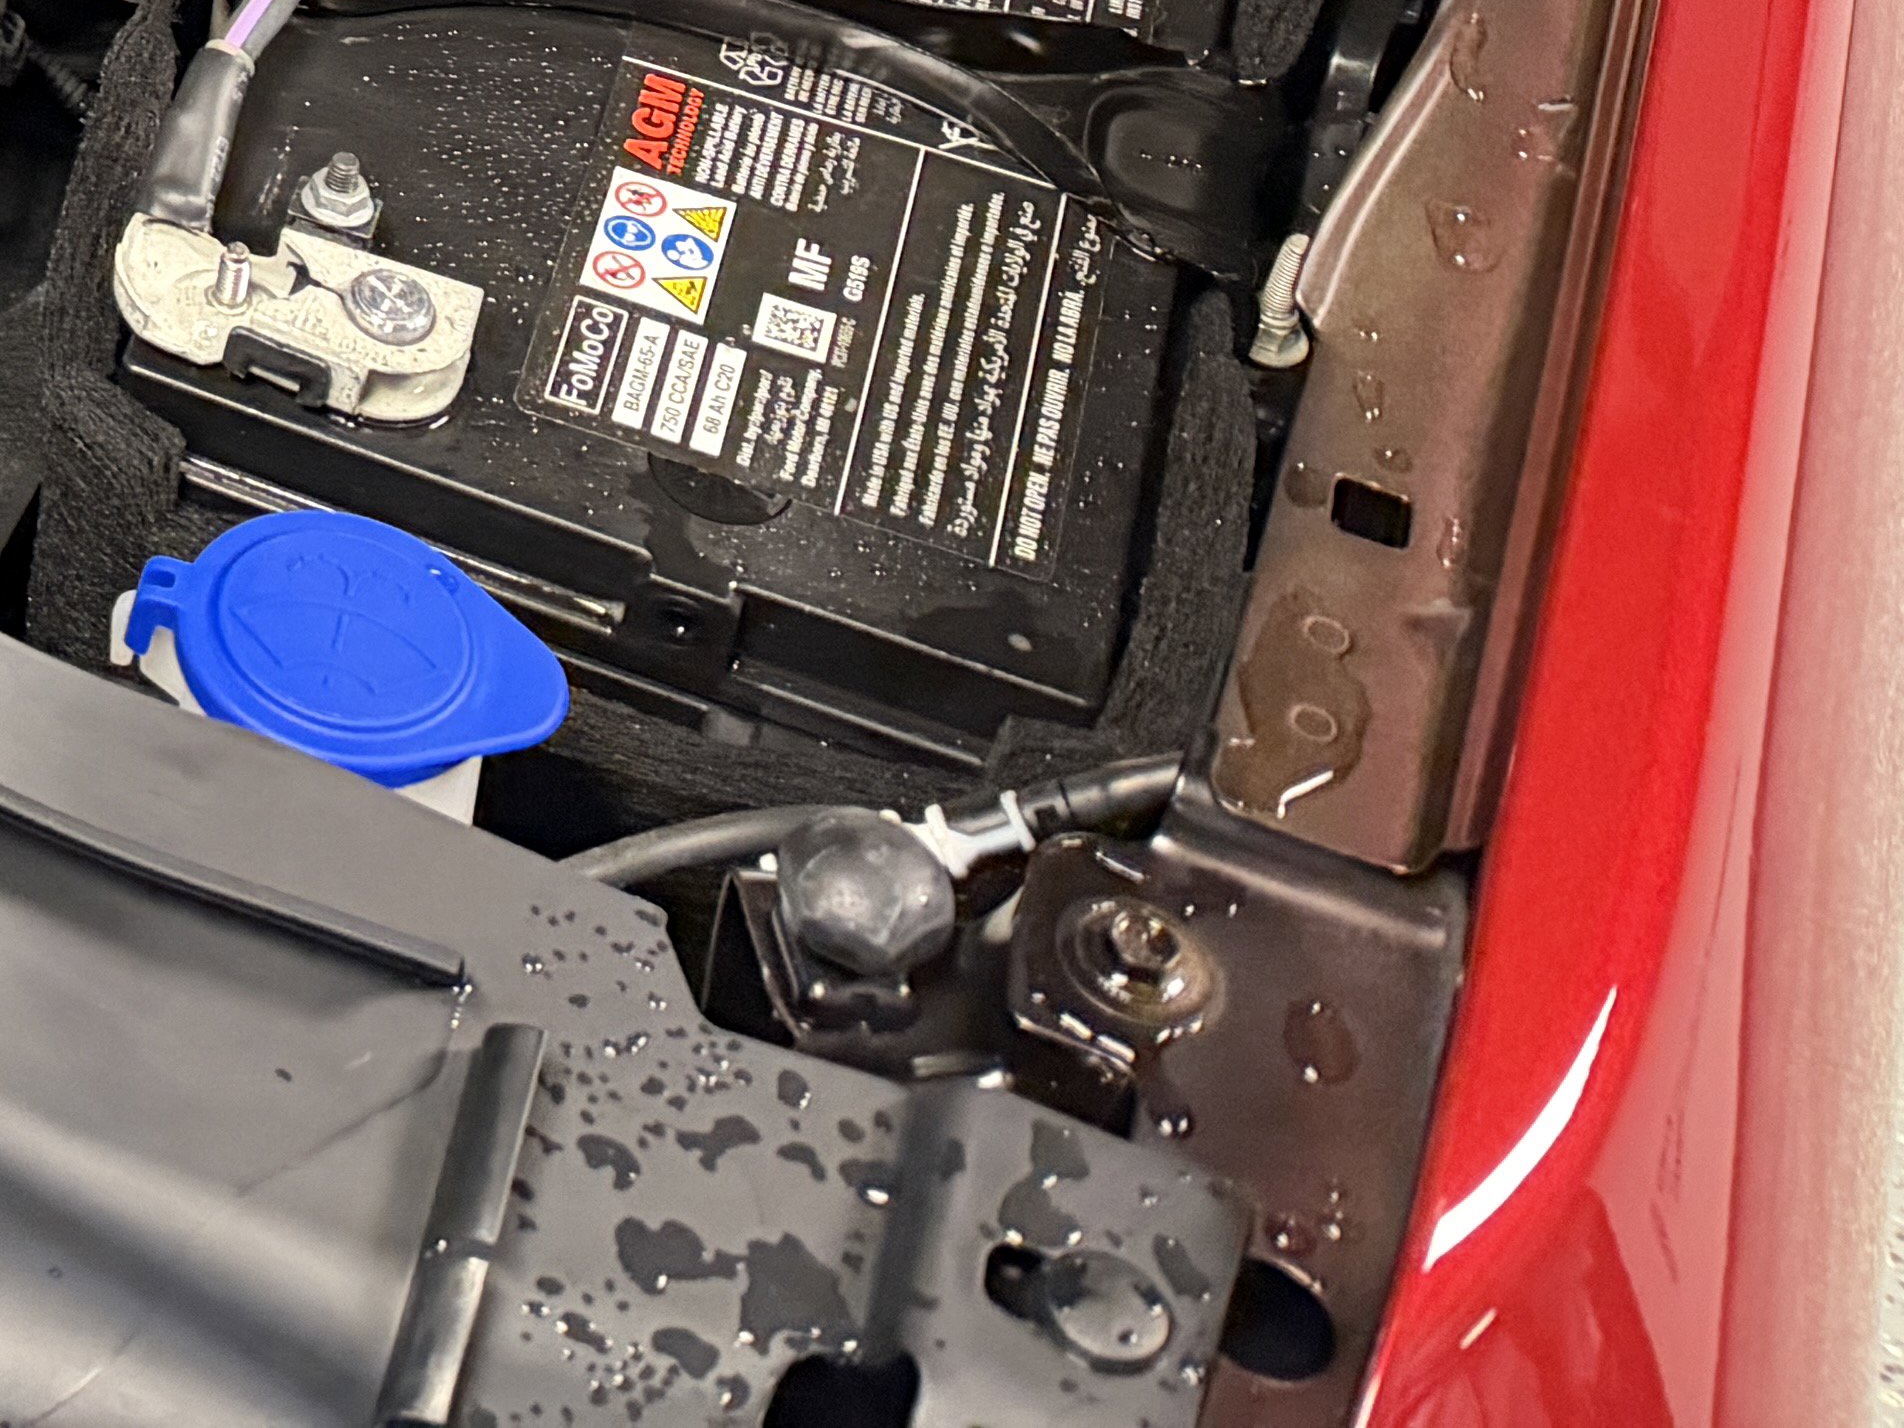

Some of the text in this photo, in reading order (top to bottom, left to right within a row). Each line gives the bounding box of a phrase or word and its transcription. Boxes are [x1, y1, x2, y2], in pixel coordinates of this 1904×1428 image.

[622, 72, 686, 170] AGM
[665, 87, 704, 176] TECHNOLOGY
[787, 237, 832, 291] MF
[842, 254, 870, 302] G519S
[558, 302, 617, 407] FoMoCo
[1051, 341, 1074, 364] NO
[1054, 325, 1077, 344] LA
[622, 334, 659, 412] BAGM-65-A
[659, 337, 700, 433] 750 CCA/SAE
[701, 363, 736, 434] 68 Ah C20
[1035, 417, 1060, 447] PAS
[1022, 470, 1051, 511] OPEN.
[1017, 505, 1042, 539] NOT
